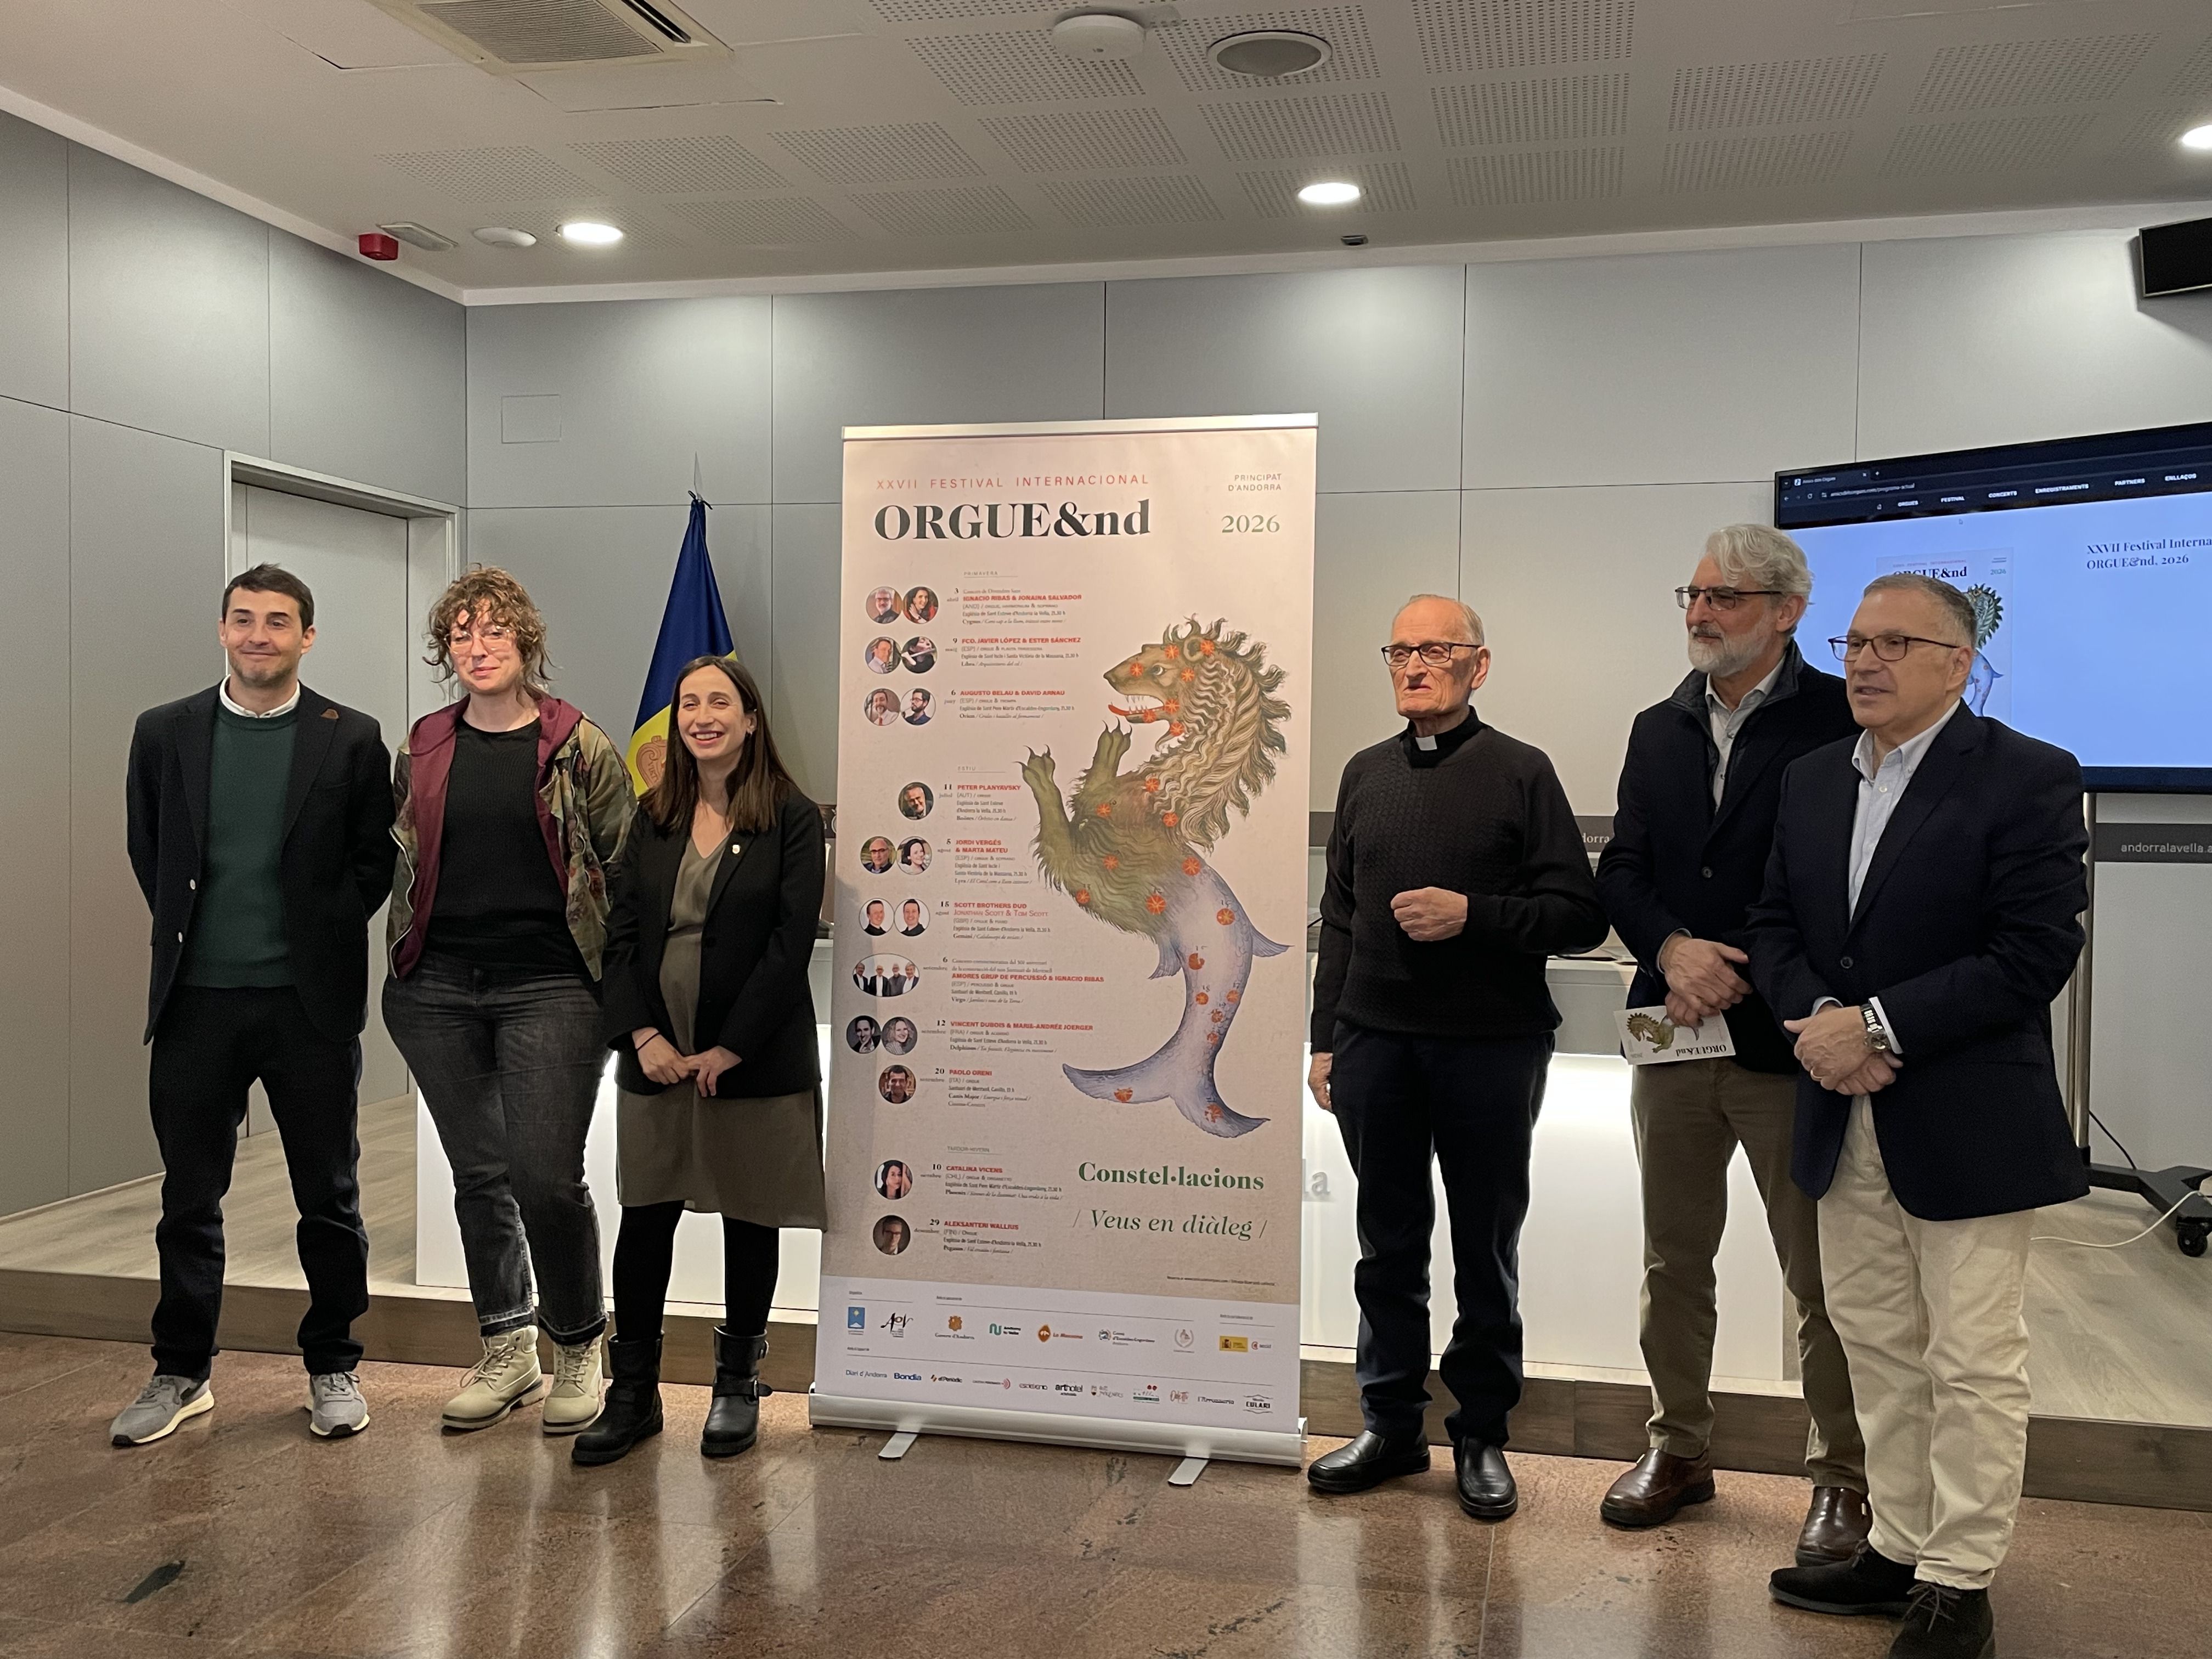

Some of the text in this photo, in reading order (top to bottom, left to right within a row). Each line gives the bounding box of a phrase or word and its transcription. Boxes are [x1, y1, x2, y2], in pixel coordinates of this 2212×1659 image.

[876, 474, 1149, 489] XXVII FESTIVAL INTERNACIONAL
[1234, 473, 1282, 482] PRINCIPAT
[2035, 483, 2089, 494] ENREGISTRAMENTS
[2114, 478, 2145, 486] PARTNERS
[2165, 473, 2197, 481] ENLLAÇOS
[1228, 483, 1282, 492] D'ANDORRA
[874, 498, 1151, 540] ORGUE&nd
[1221, 514, 1280, 533] 2026
[2087, 537, 2212, 554] XXVII Festival Interna
[2162, 554, 2190, 565] 2026
[1091, 1209, 1141, 1231] Veus
[1148, 1217, 1173, 1232] en
[1183, 1214, 1252, 1242] diàleg
[894, 1372, 922, 1381] Bondia
[1054, 1384, 1084, 1392] arthotel
